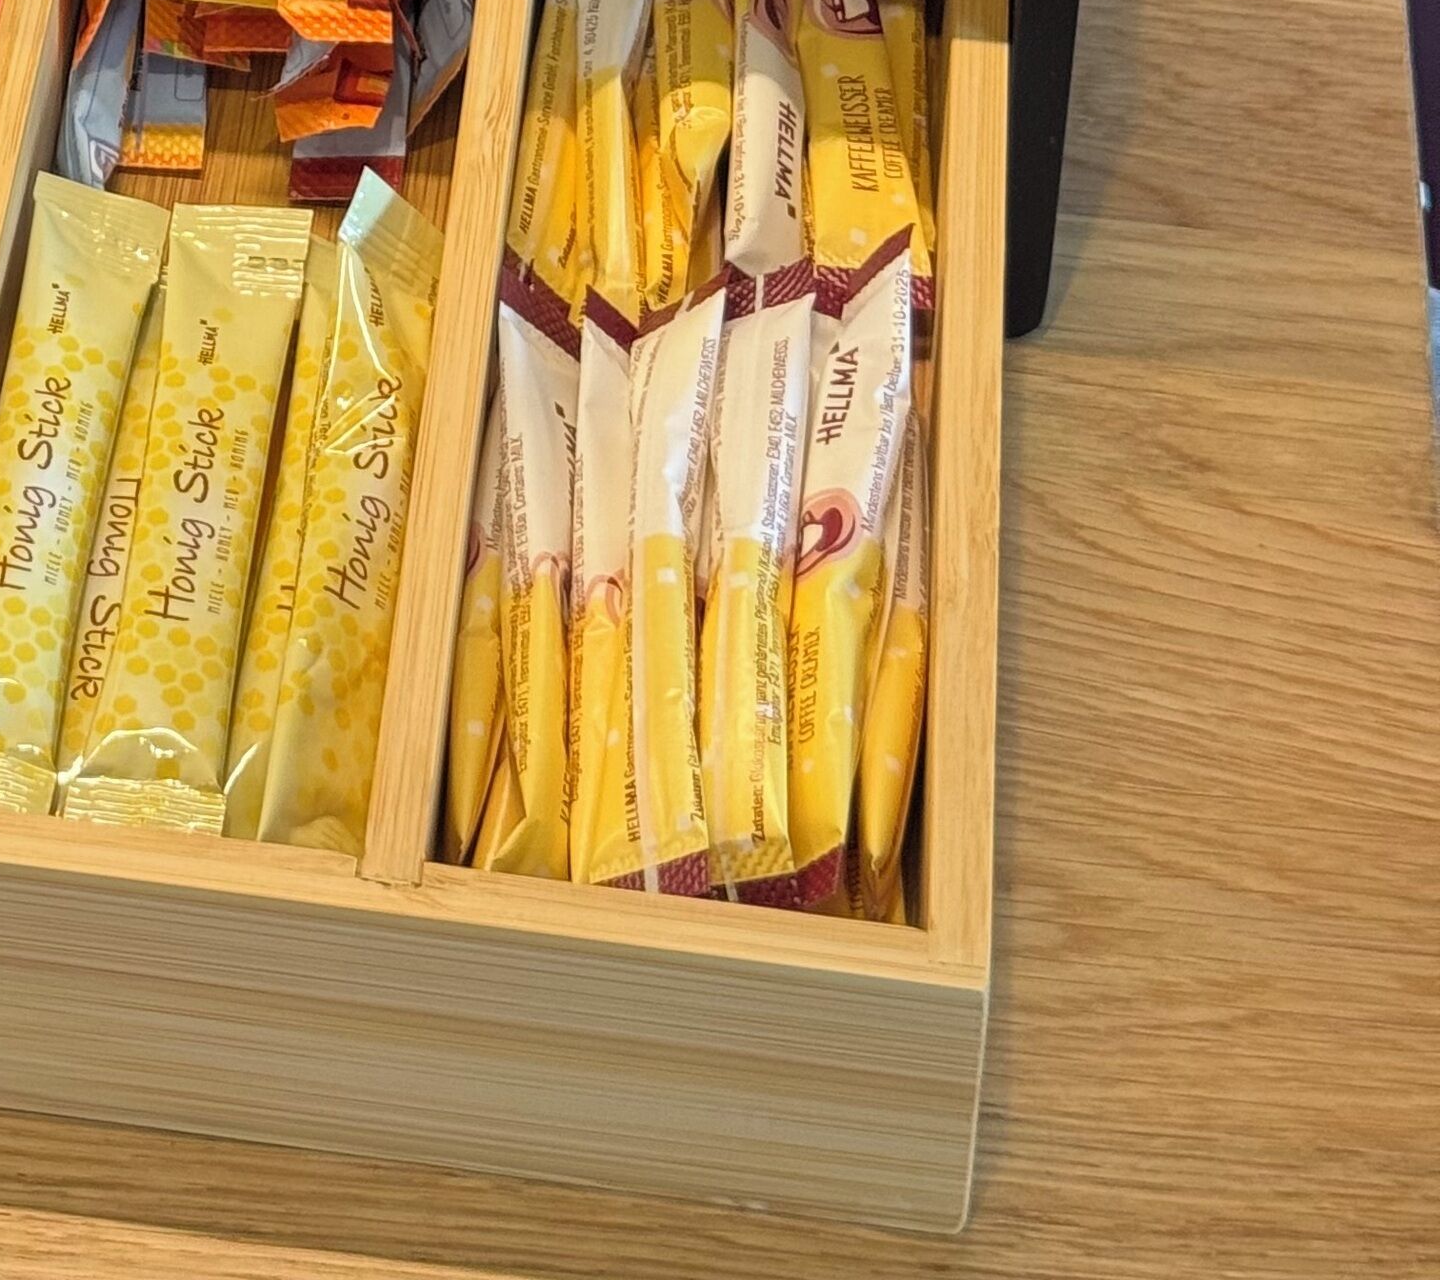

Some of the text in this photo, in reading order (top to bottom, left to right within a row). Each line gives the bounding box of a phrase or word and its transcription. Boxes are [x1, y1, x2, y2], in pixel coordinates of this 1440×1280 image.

[773, 101, 797, 201] HELLMA
[836, 74, 880, 193] KAFFEEWEISSER
[879, 138, 905, 180] COFFEE
[518, 186, 538, 234] HELLMA
[16, 376, 72, 470] Stick
[813, 345, 860, 446] HELLMA
[877, 417, 893, 434] bis
[872, 434, 890, 471] haltbar
[143, 407, 225, 622] Honig Stick
[322, 374, 403, 612] Honig Stick
[860, 471, 883, 533] Mindestens
[70, 594, 122, 701] Stick
[796, 699, 819, 744] COFFEE
[625, 778, 641, 842] HELLMA
